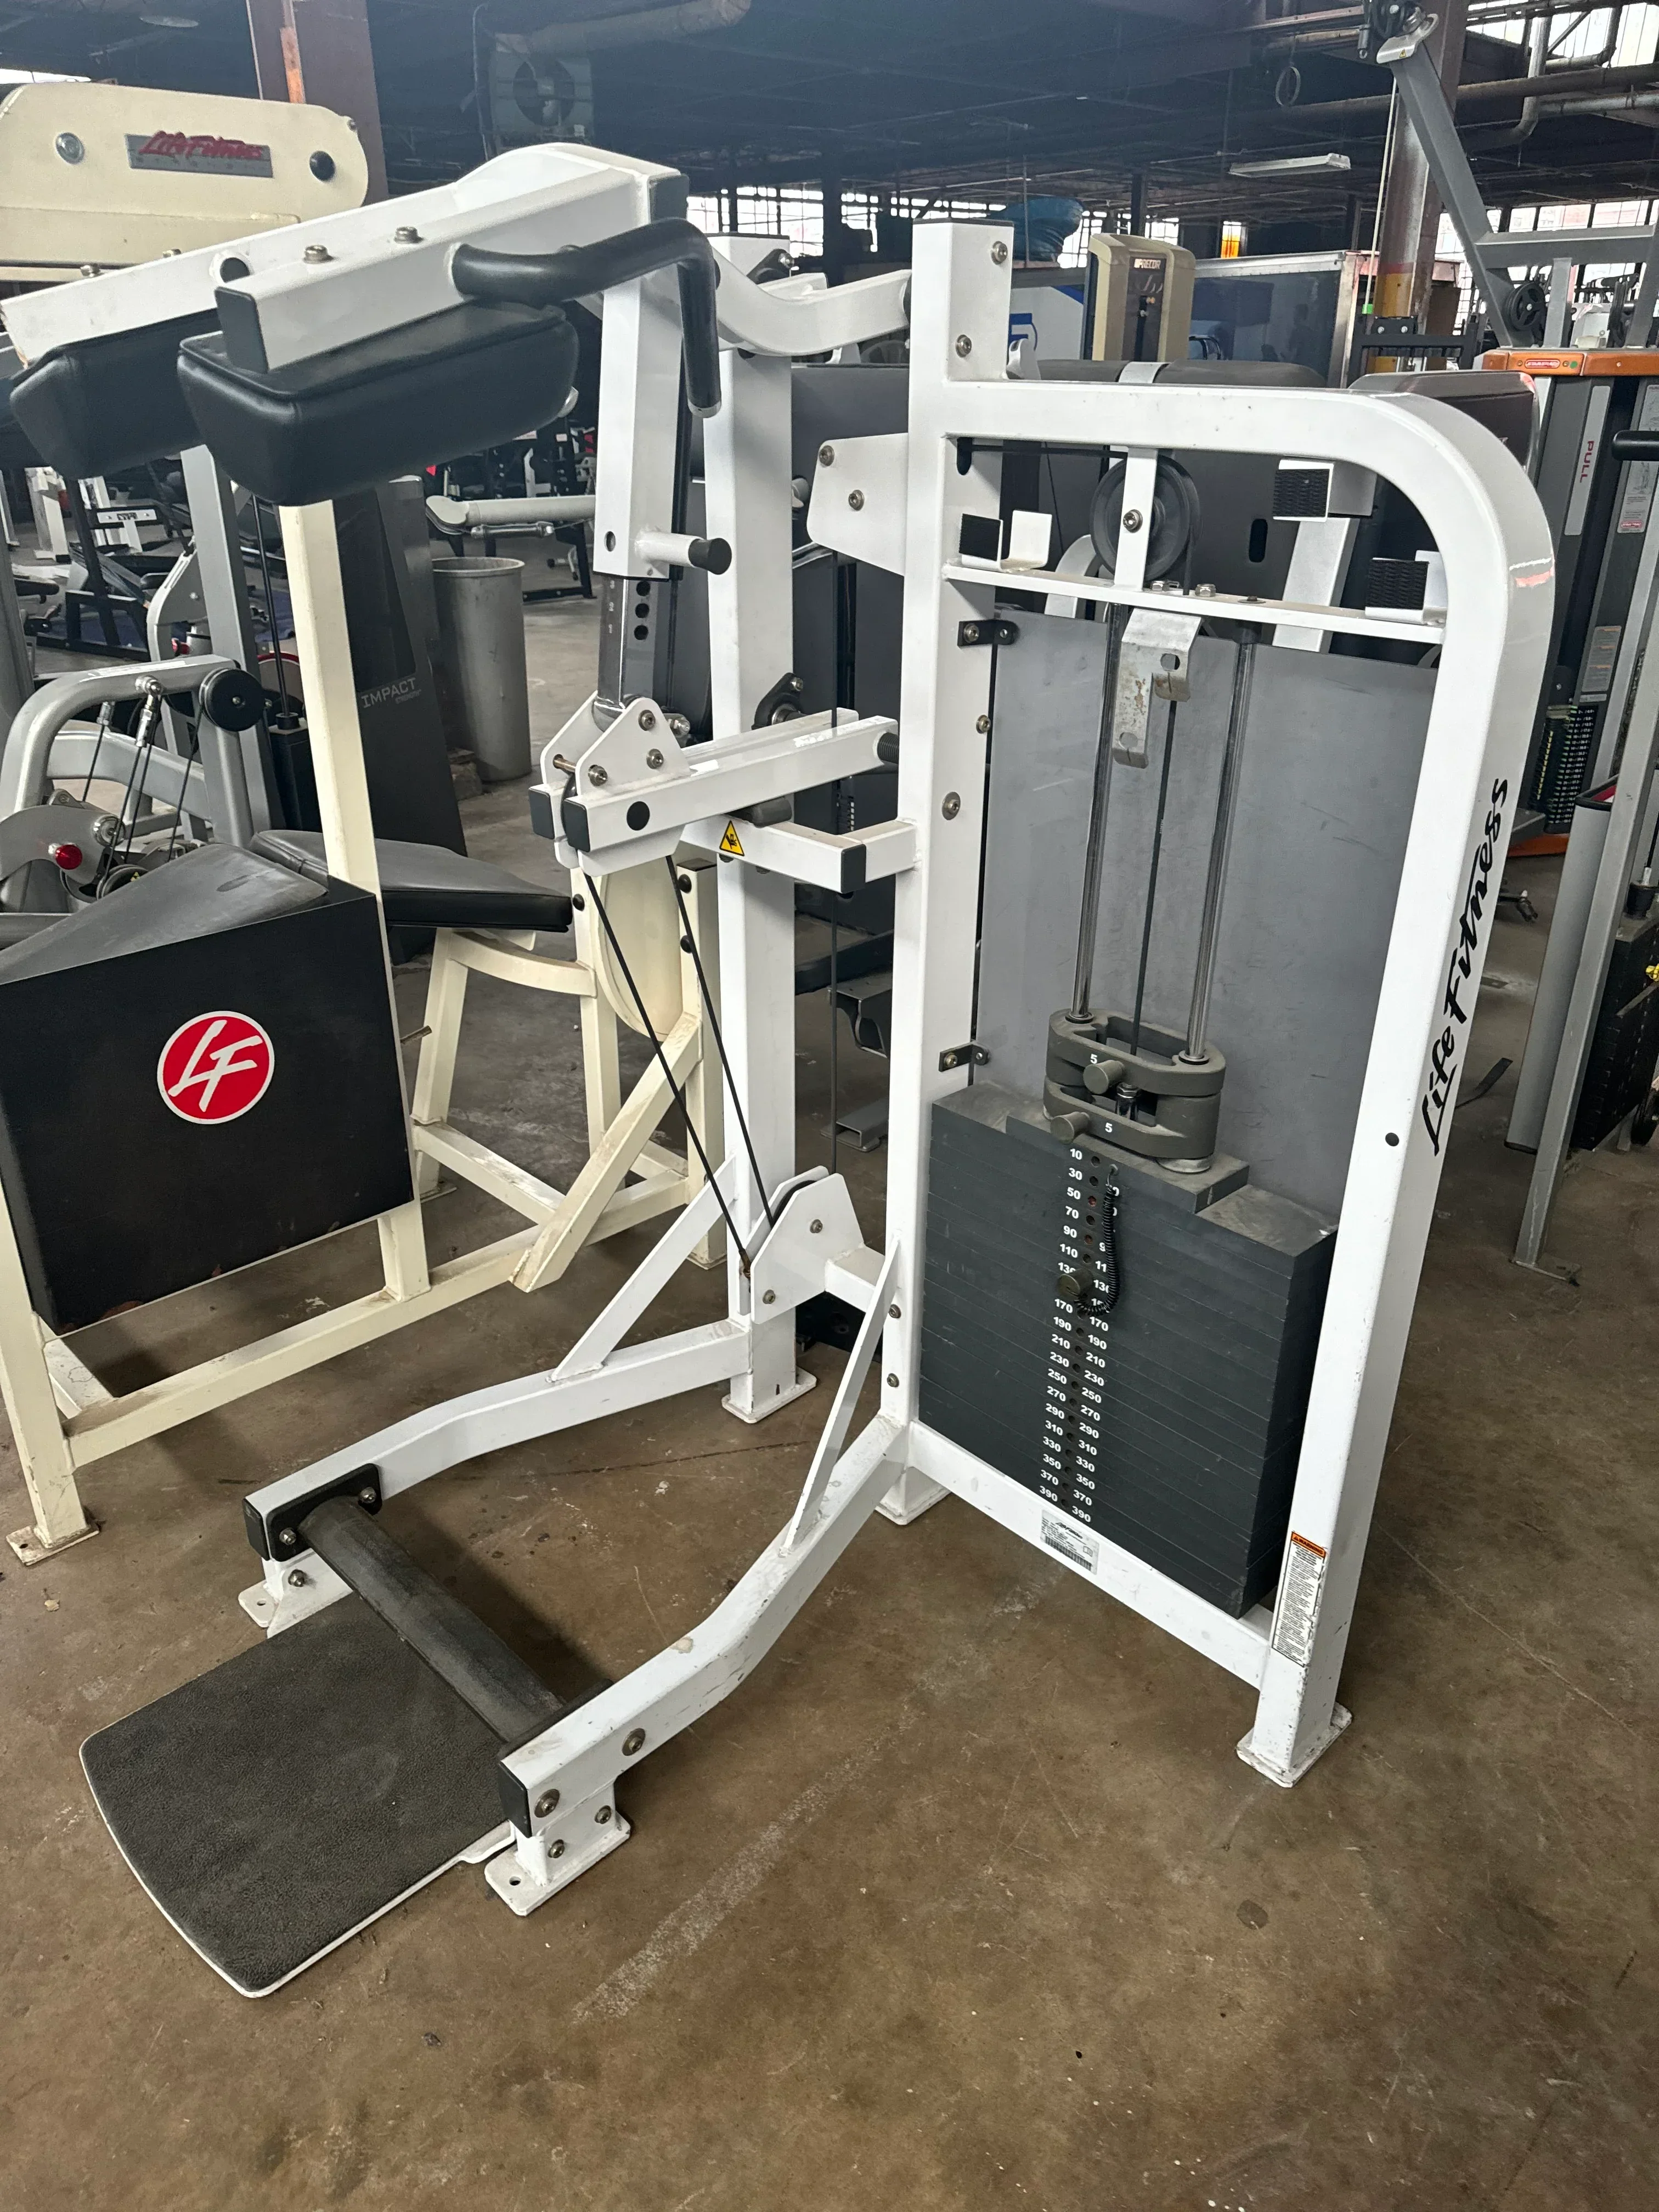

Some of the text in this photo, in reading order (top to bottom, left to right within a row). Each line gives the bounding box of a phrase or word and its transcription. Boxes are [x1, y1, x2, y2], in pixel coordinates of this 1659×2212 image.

[1579, 441, 1595, 483] PULL
[361, 678, 416, 709] IMPACT
[1422, 778, 1509, 1157] Life Fitness
[1090, 1053, 1098, 1064] 5
[1105, 1122, 1113, 1133] 5
[1070, 1148, 1082, 1160] 10
[1068, 1167, 1082, 1181] 30
[1066, 1187, 1081, 1200] 50
[1065, 1205, 1079, 1219] 70
[1063, 1225, 1077, 1238] 90
[1059, 1243, 1078, 1259] 110
[1095, 1260, 1107, 1273] 11
[1093, 1279, 1109, 1294] 13
[1054, 1298, 1073, 1313] 170
[1053, 1316, 1072, 1331] 190
[1089, 1316, 1109, 1331] 170
[1051, 1334, 1070, 1350] 210
[1087, 1334, 1107, 1350] 190
[1049, 1351, 1070, 1368] 230
[1085, 1352, 1105, 1368] 210
[1047, 1368, 1067, 1385] 250
[1084, 1370, 1104, 1386] 230
[1047, 1385, 1066, 1402] 270
[1081, 1387, 1102, 1403] 250
[1045, 1403, 1065, 1419] 290
[1080, 1404, 1101, 1421] 270
[1045, 1420, 1063, 1436] 310
[1079, 1422, 1099, 1439] 290
[1042, 1436, 1061, 1452] 330
[1078, 1439, 1097, 1455] 310
[1043, 1453, 1062, 1470] 350
[1075, 1455, 1095, 1472] 330
[1040, 1469, 1059, 1486] 370
[1076, 1473, 1095, 1490] 350
[1039, 1485, 1058, 1502] 390
[1073, 1489, 1092, 1506] 370
[1071, 1505, 1091, 1522] 390
